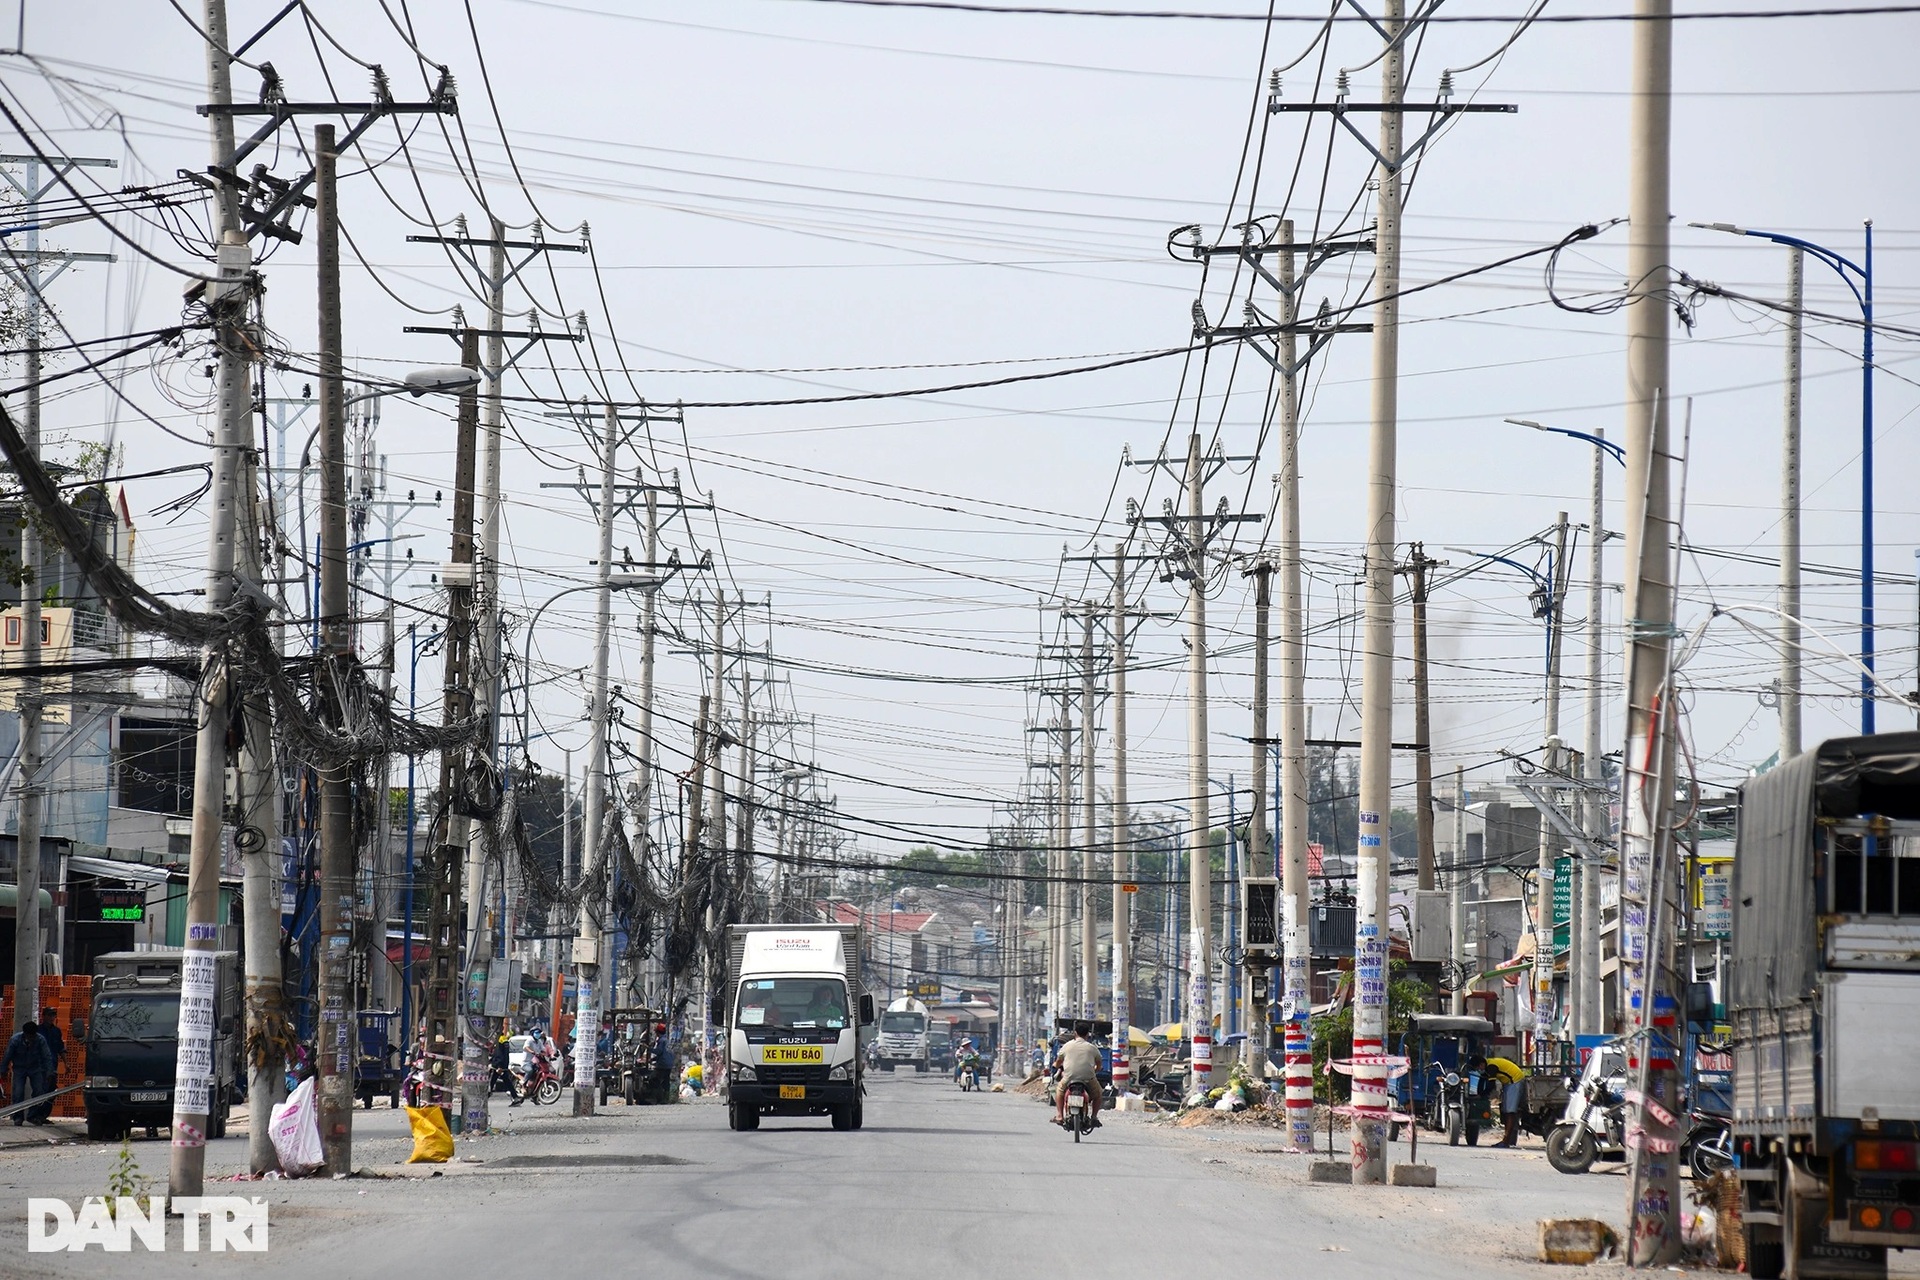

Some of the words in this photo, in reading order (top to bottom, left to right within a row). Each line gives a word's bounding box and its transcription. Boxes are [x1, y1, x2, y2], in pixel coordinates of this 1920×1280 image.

[191, 957, 202, 966] VAY
[191, 998, 202, 1007] VAY
[765, 1049, 777, 1059] XE
[780, 1048, 799, 1059] THƯ
[801, 1047, 821, 1059] BÁO
[1811, 1245, 1872, 1260] HOWO
